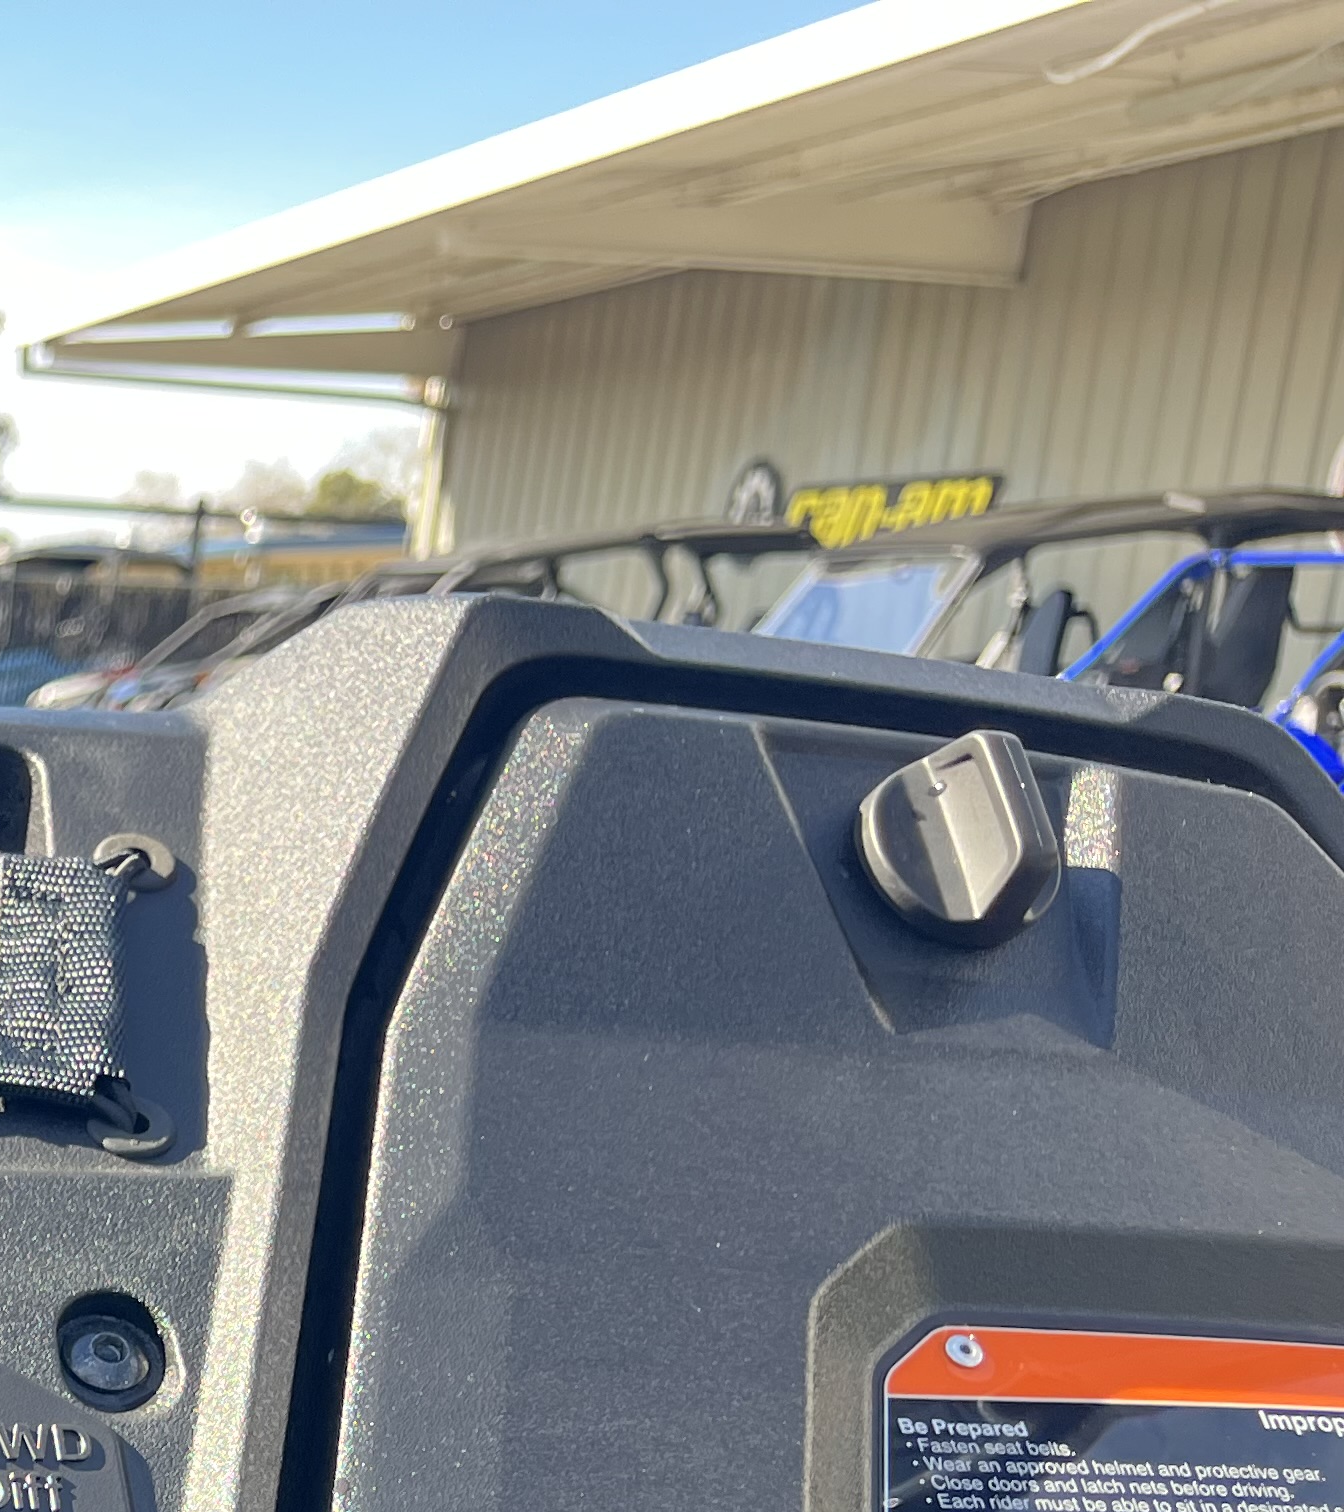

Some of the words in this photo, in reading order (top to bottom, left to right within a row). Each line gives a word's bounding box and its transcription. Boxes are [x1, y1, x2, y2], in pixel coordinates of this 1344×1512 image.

[897, 1417, 929, 1435] Be
[931, 1418, 1029, 1440] Prepared
[917, 1437, 981, 1454] Fasten
[984, 1441, 1024, 1456] seat
[1026, 1440, 1076, 1457] belts.
[922, 1456, 972, 1472] Wear
[977, 1461, 1002, 1473] an
[1006, 1459, 1090, 1476] approved
[1092, 1459, 1154, 1476] helmet
[1158, 1462, 1192, 1478] and
[1195, 1464, 1279, 1481] protective
[1282, 1468, 1326, 1484] gear.
[930, 1474, 984, 1491] Close
[988, 1476, 1039, 1492] doors
[1043, 1478, 1078, 1494] and
[1080, 1478, 1125, 1494] latch
[1129, 1481, 1168, 1495] nets
[1171, 1480, 1228, 1497] before
[1232, 1482, 1295, 1502] driving.
[937, 1493, 985, 1510] Each
[989, 1494, 1030, 1511] rider
[1035, 1498, 1080, 1512] must
[1081, 1497, 1107, 1512] be
[1111, 1497, 1150, 1512] able
